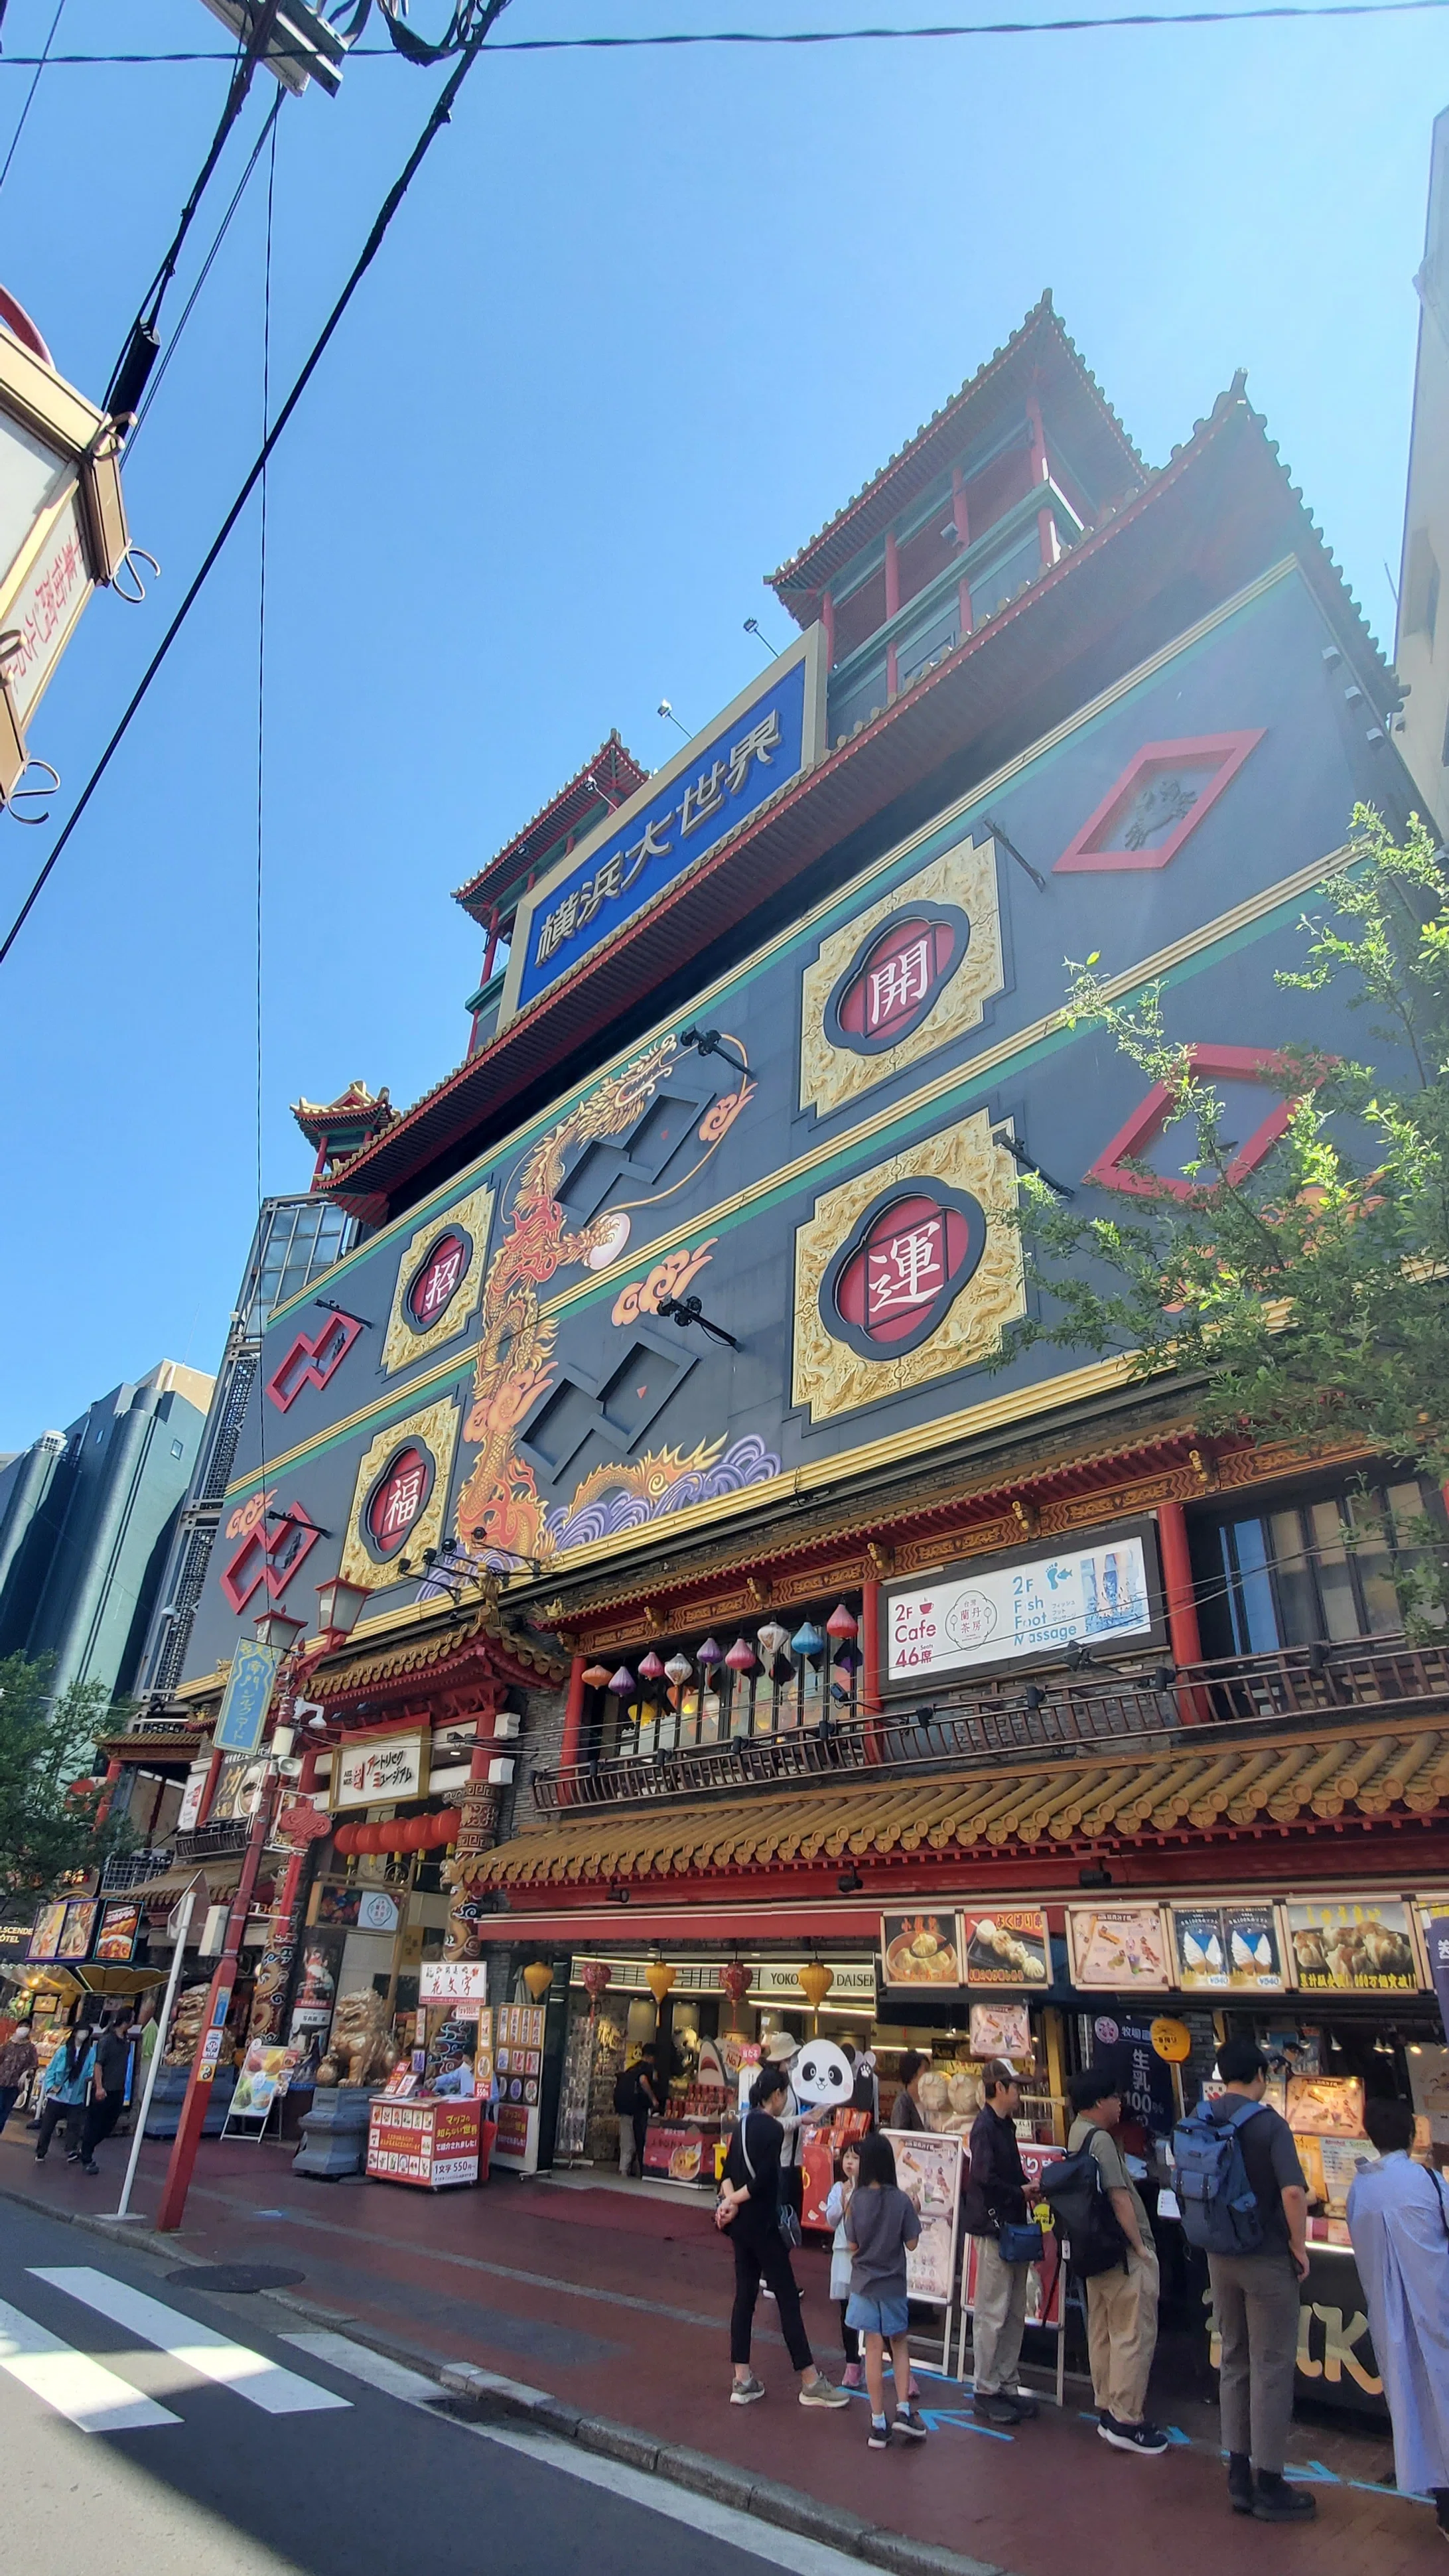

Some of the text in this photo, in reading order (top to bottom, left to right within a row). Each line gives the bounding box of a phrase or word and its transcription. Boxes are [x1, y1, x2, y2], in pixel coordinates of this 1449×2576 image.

[534, 708, 782, 968] 横浜大世界
[870, 939, 929, 1025] 開
[425, 1252, 460, 1311] 招
[868, 1221, 945, 1313] 運
[385, 1470, 421, 1532] 福
[896, 1604, 913, 1622] 2F
[1013, 1576, 1034, 1595] 2F
[1014, 1595, 1044, 1614] Fsh
[895, 1619, 937, 1644] Cafe
[235, 1660, 265, 1742] 南門シルクロード
[372, 1766, 412, 1788] ミュージアム
